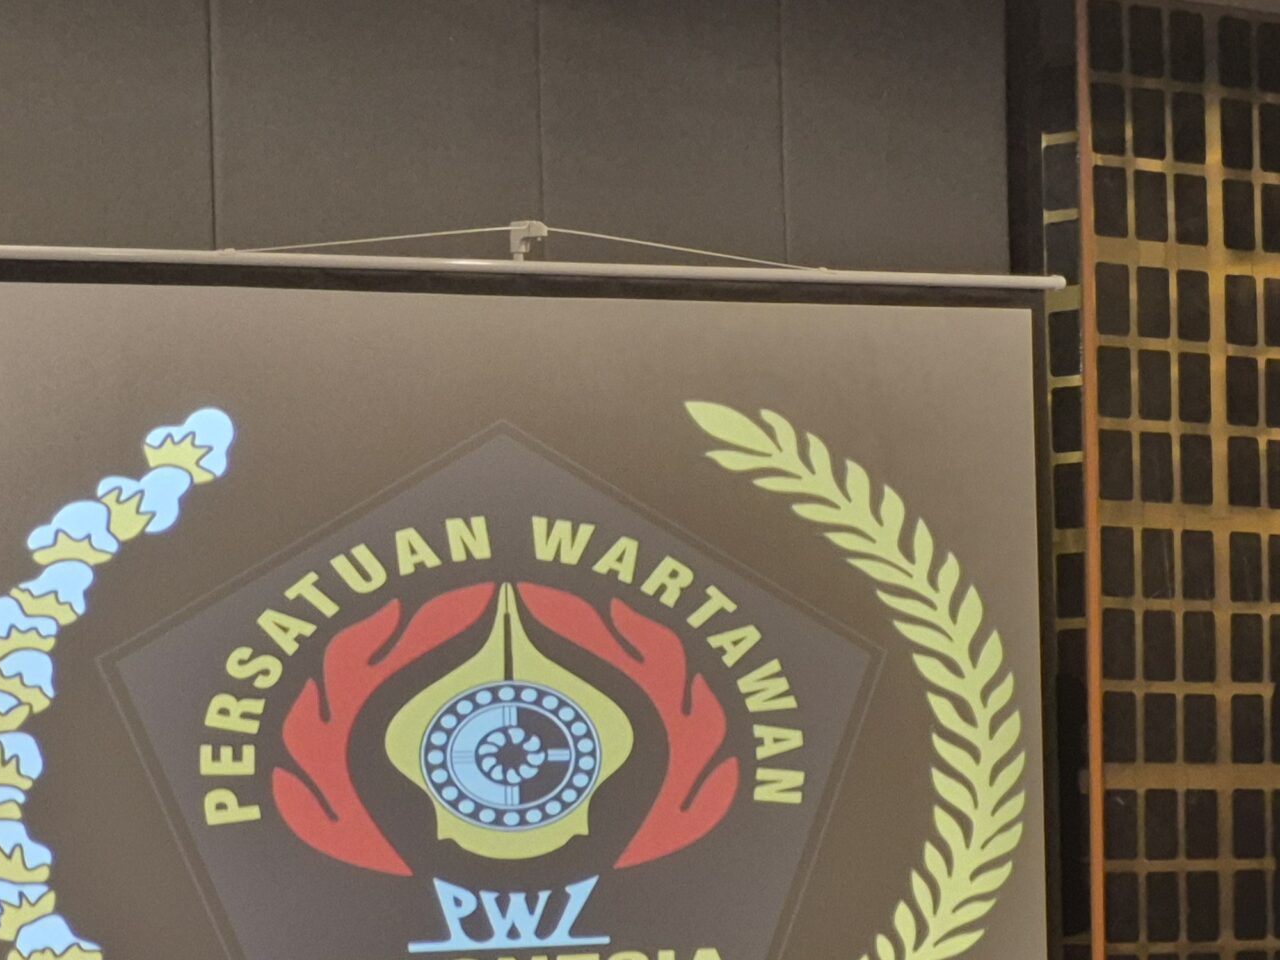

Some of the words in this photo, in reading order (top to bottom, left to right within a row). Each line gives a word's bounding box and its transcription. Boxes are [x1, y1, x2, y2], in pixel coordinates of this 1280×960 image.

[199, 515, 492, 826] PERSATUAN
[531, 515, 806, 804] WARTAWAN
[408, 874, 611, 953] PWI
